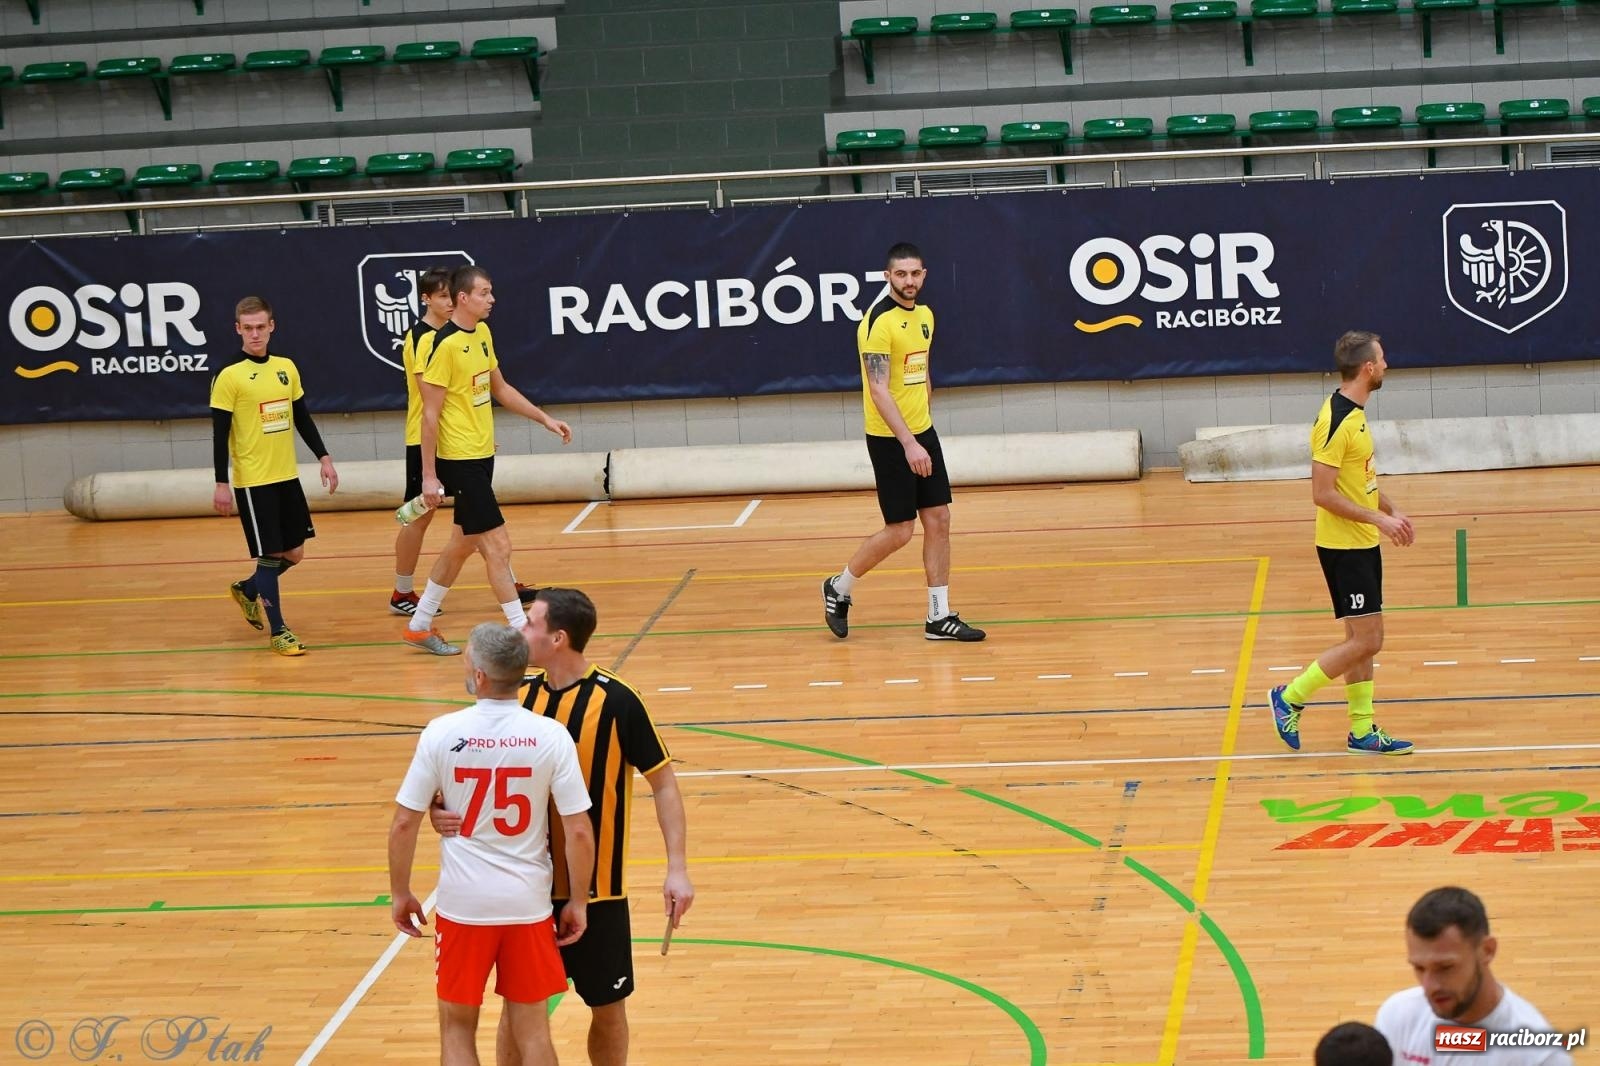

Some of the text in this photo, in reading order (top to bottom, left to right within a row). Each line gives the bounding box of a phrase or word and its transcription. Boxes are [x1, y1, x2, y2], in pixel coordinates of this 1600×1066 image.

[1069, 232, 1280, 306] OSiR
[8, 281, 207, 352] OSiR
[1156, 302, 1283, 329] RACIBÓRZ
[91, 350, 209, 375] RACIBÓRZ
[1350, 593, 1365, 609] 19
[468, 737, 496, 749] PRD
[454, 767, 532, 838] 75
